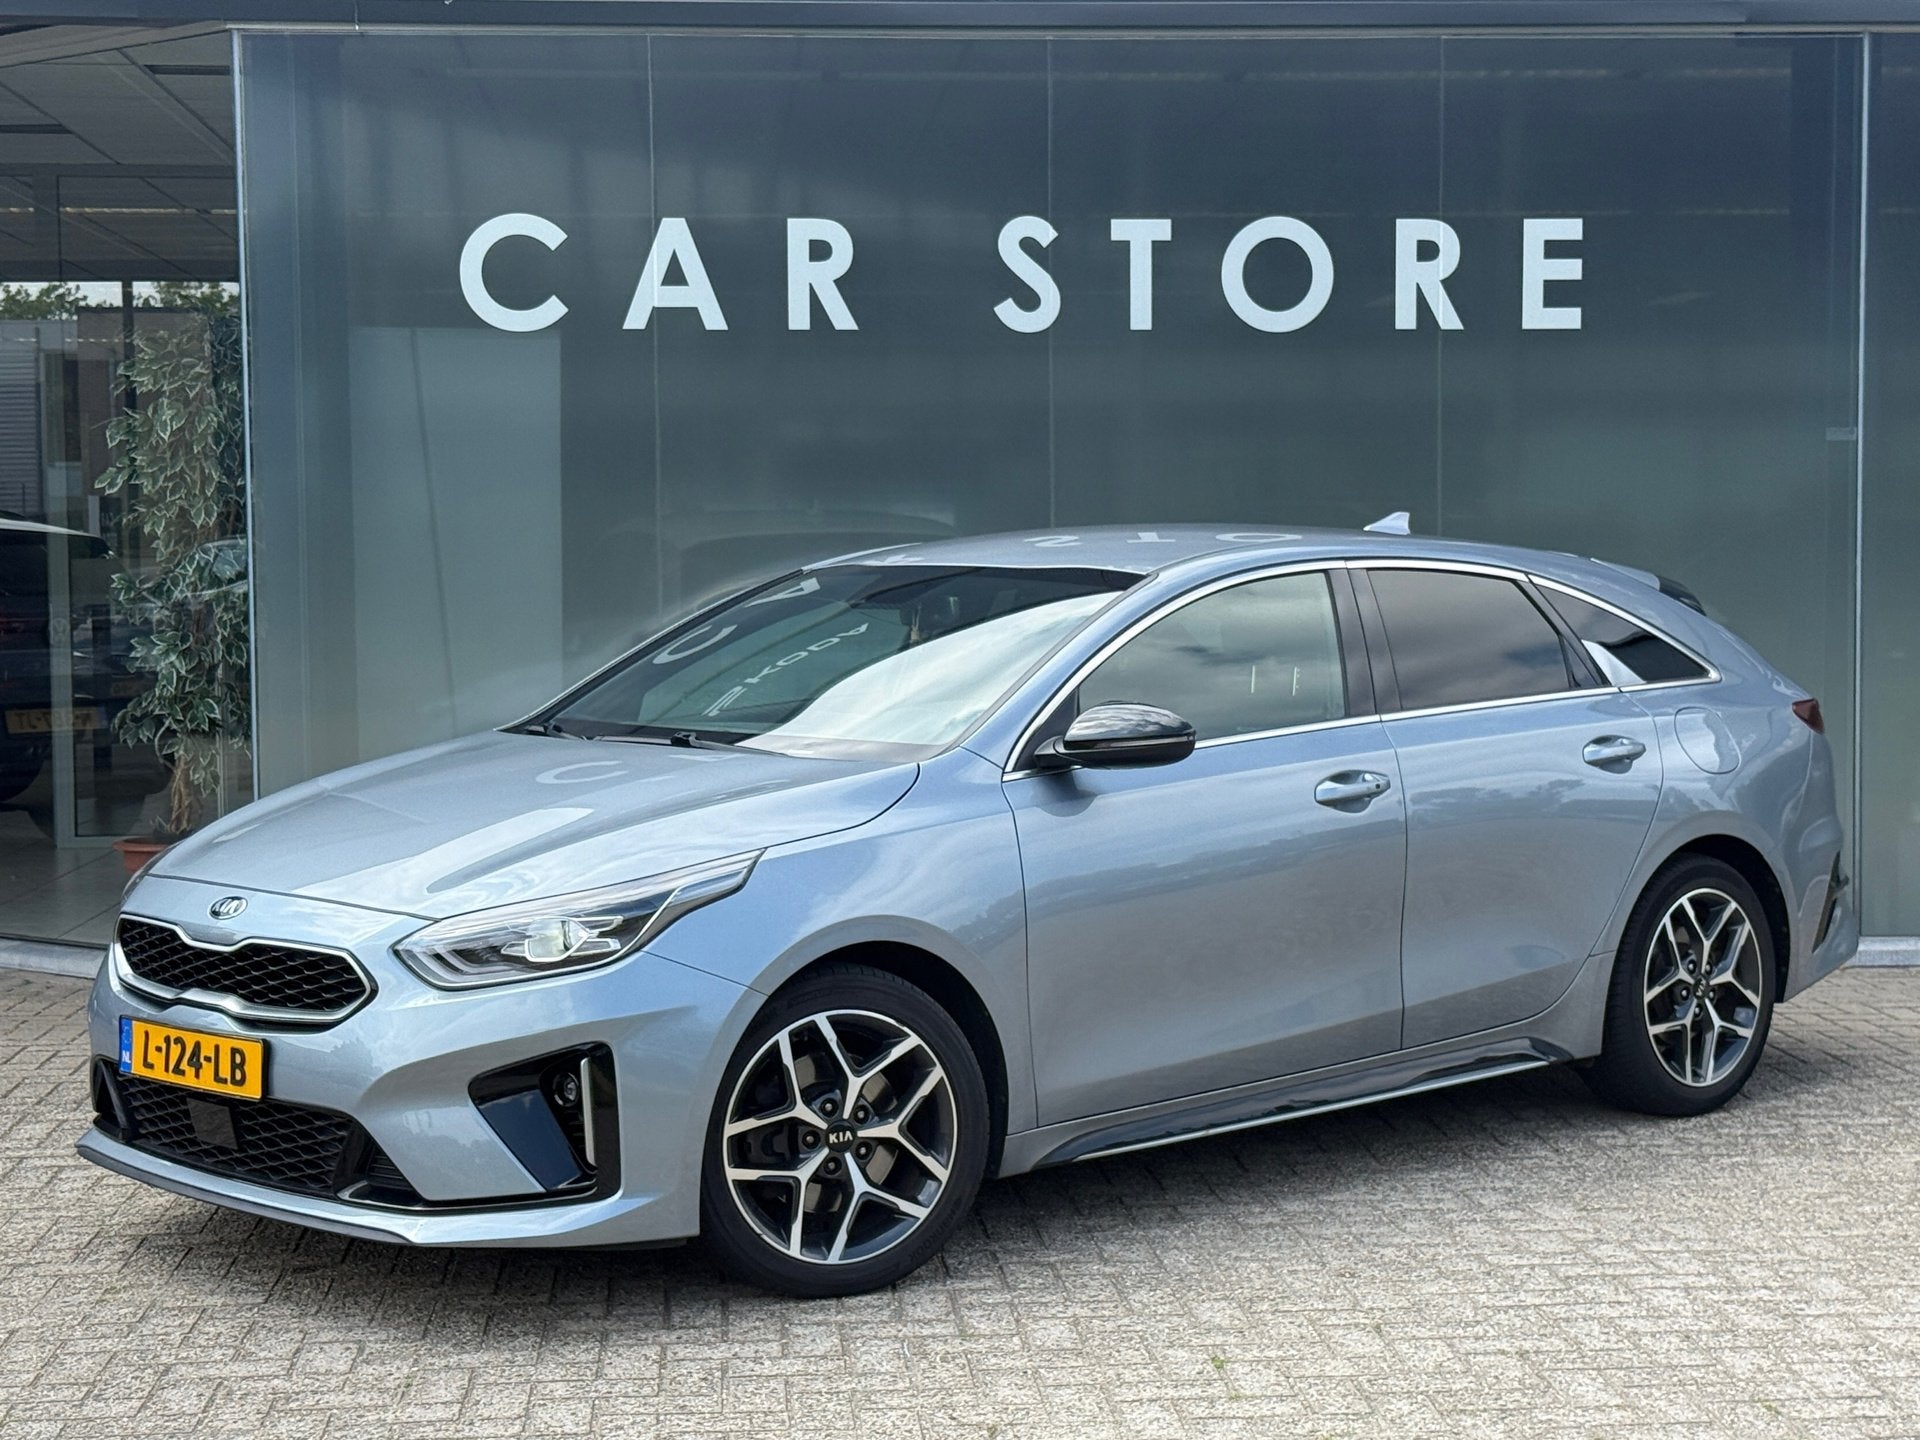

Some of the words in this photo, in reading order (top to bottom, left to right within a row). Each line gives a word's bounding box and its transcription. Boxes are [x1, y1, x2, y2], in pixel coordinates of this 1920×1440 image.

[460, 213, 858, 331] CAR
[994, 216, 1582, 332] STORE
[142, 1029, 247, 1087] L-124-LB
[828, 1130, 853, 1144] KIA
